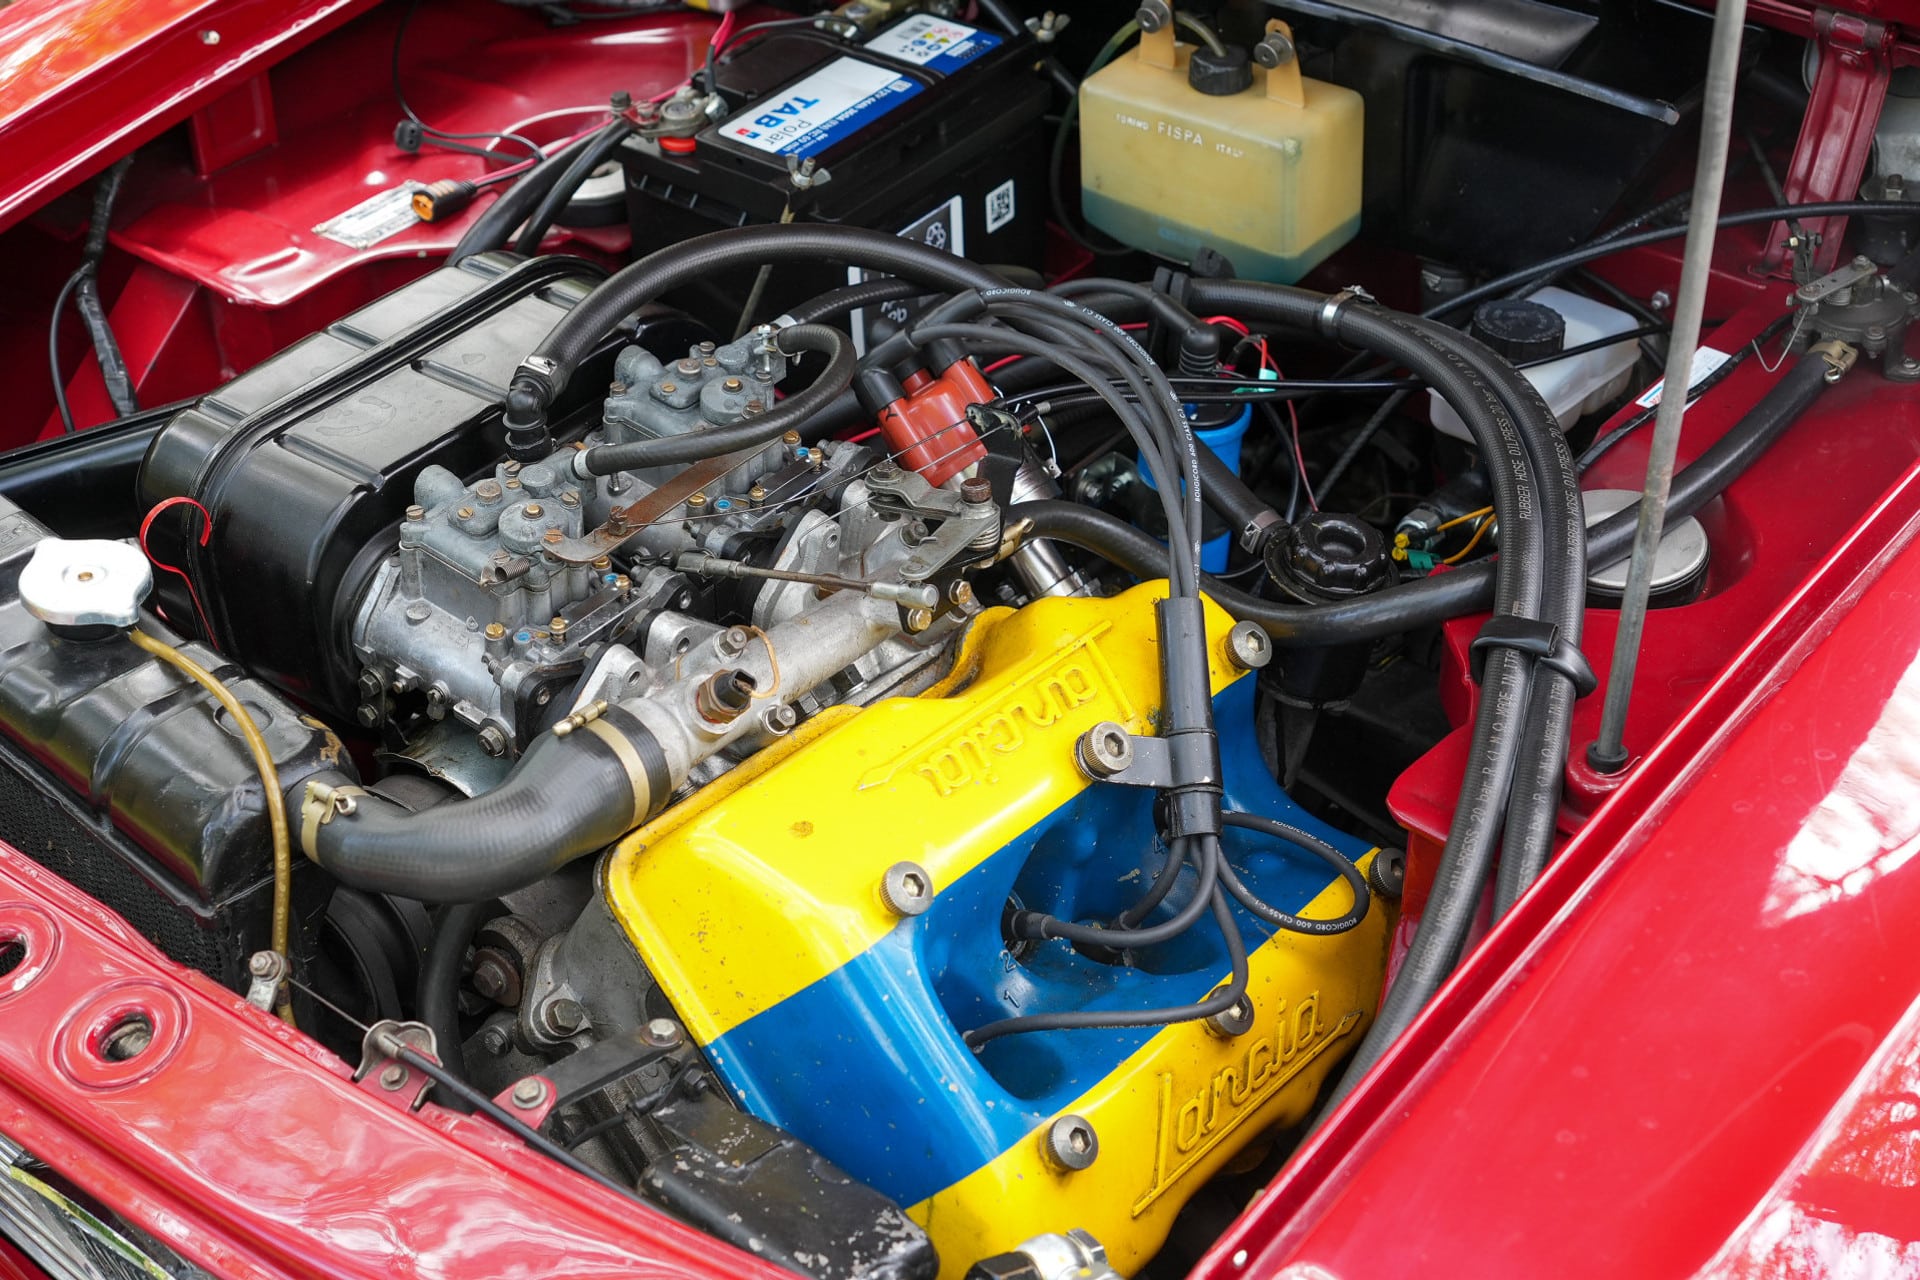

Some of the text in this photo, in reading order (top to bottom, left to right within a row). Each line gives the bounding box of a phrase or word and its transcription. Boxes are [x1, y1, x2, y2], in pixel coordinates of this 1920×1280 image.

[754, 96, 820, 128] TAB
[764, 119, 813, 146] Polar
[1157, 121, 1203, 145] FISPA
[1216, 143, 1244, 158] ITALY
[986, 287, 1032, 296] BOUGICORD
[1094, 313, 1114, 327] CLASS
[1126, 336, 1156, 366] BOUGICORD
[1183, 419, 1193, 441] CLASS
[1496, 417, 1521, 456] OILPRESS
[1511, 459, 1528, 482] HOSE
[1554, 442, 1577, 488] OILPRESS
[1191, 459, 1201, 503] BOUGICORD
[1517, 483, 1533, 521] RUBBER
[1564, 490, 1580, 517] HOSE
[1567, 518, 1581, 557] RUBBER
[1502, 673, 1518, 687] IN
[908, 635, 1135, 796] Lancia
[1496, 691, 1514, 717] MADE
[1475, 784, 1494, 802] bar
[1470, 807, 1486, 823] 20
[1528, 812, 1546, 832] bar
[1450, 828, 1481, 889] OILPRESS
[1269, 909, 1293, 925] CLASS
[1296, 919, 1312, 929] 600
[1000, 949, 1017, 973] 2
[1412, 934, 1442, 985] RUBBER
[1003, 990, 1021, 1008] 1
[1152, 990, 1324, 1190] Lancia
